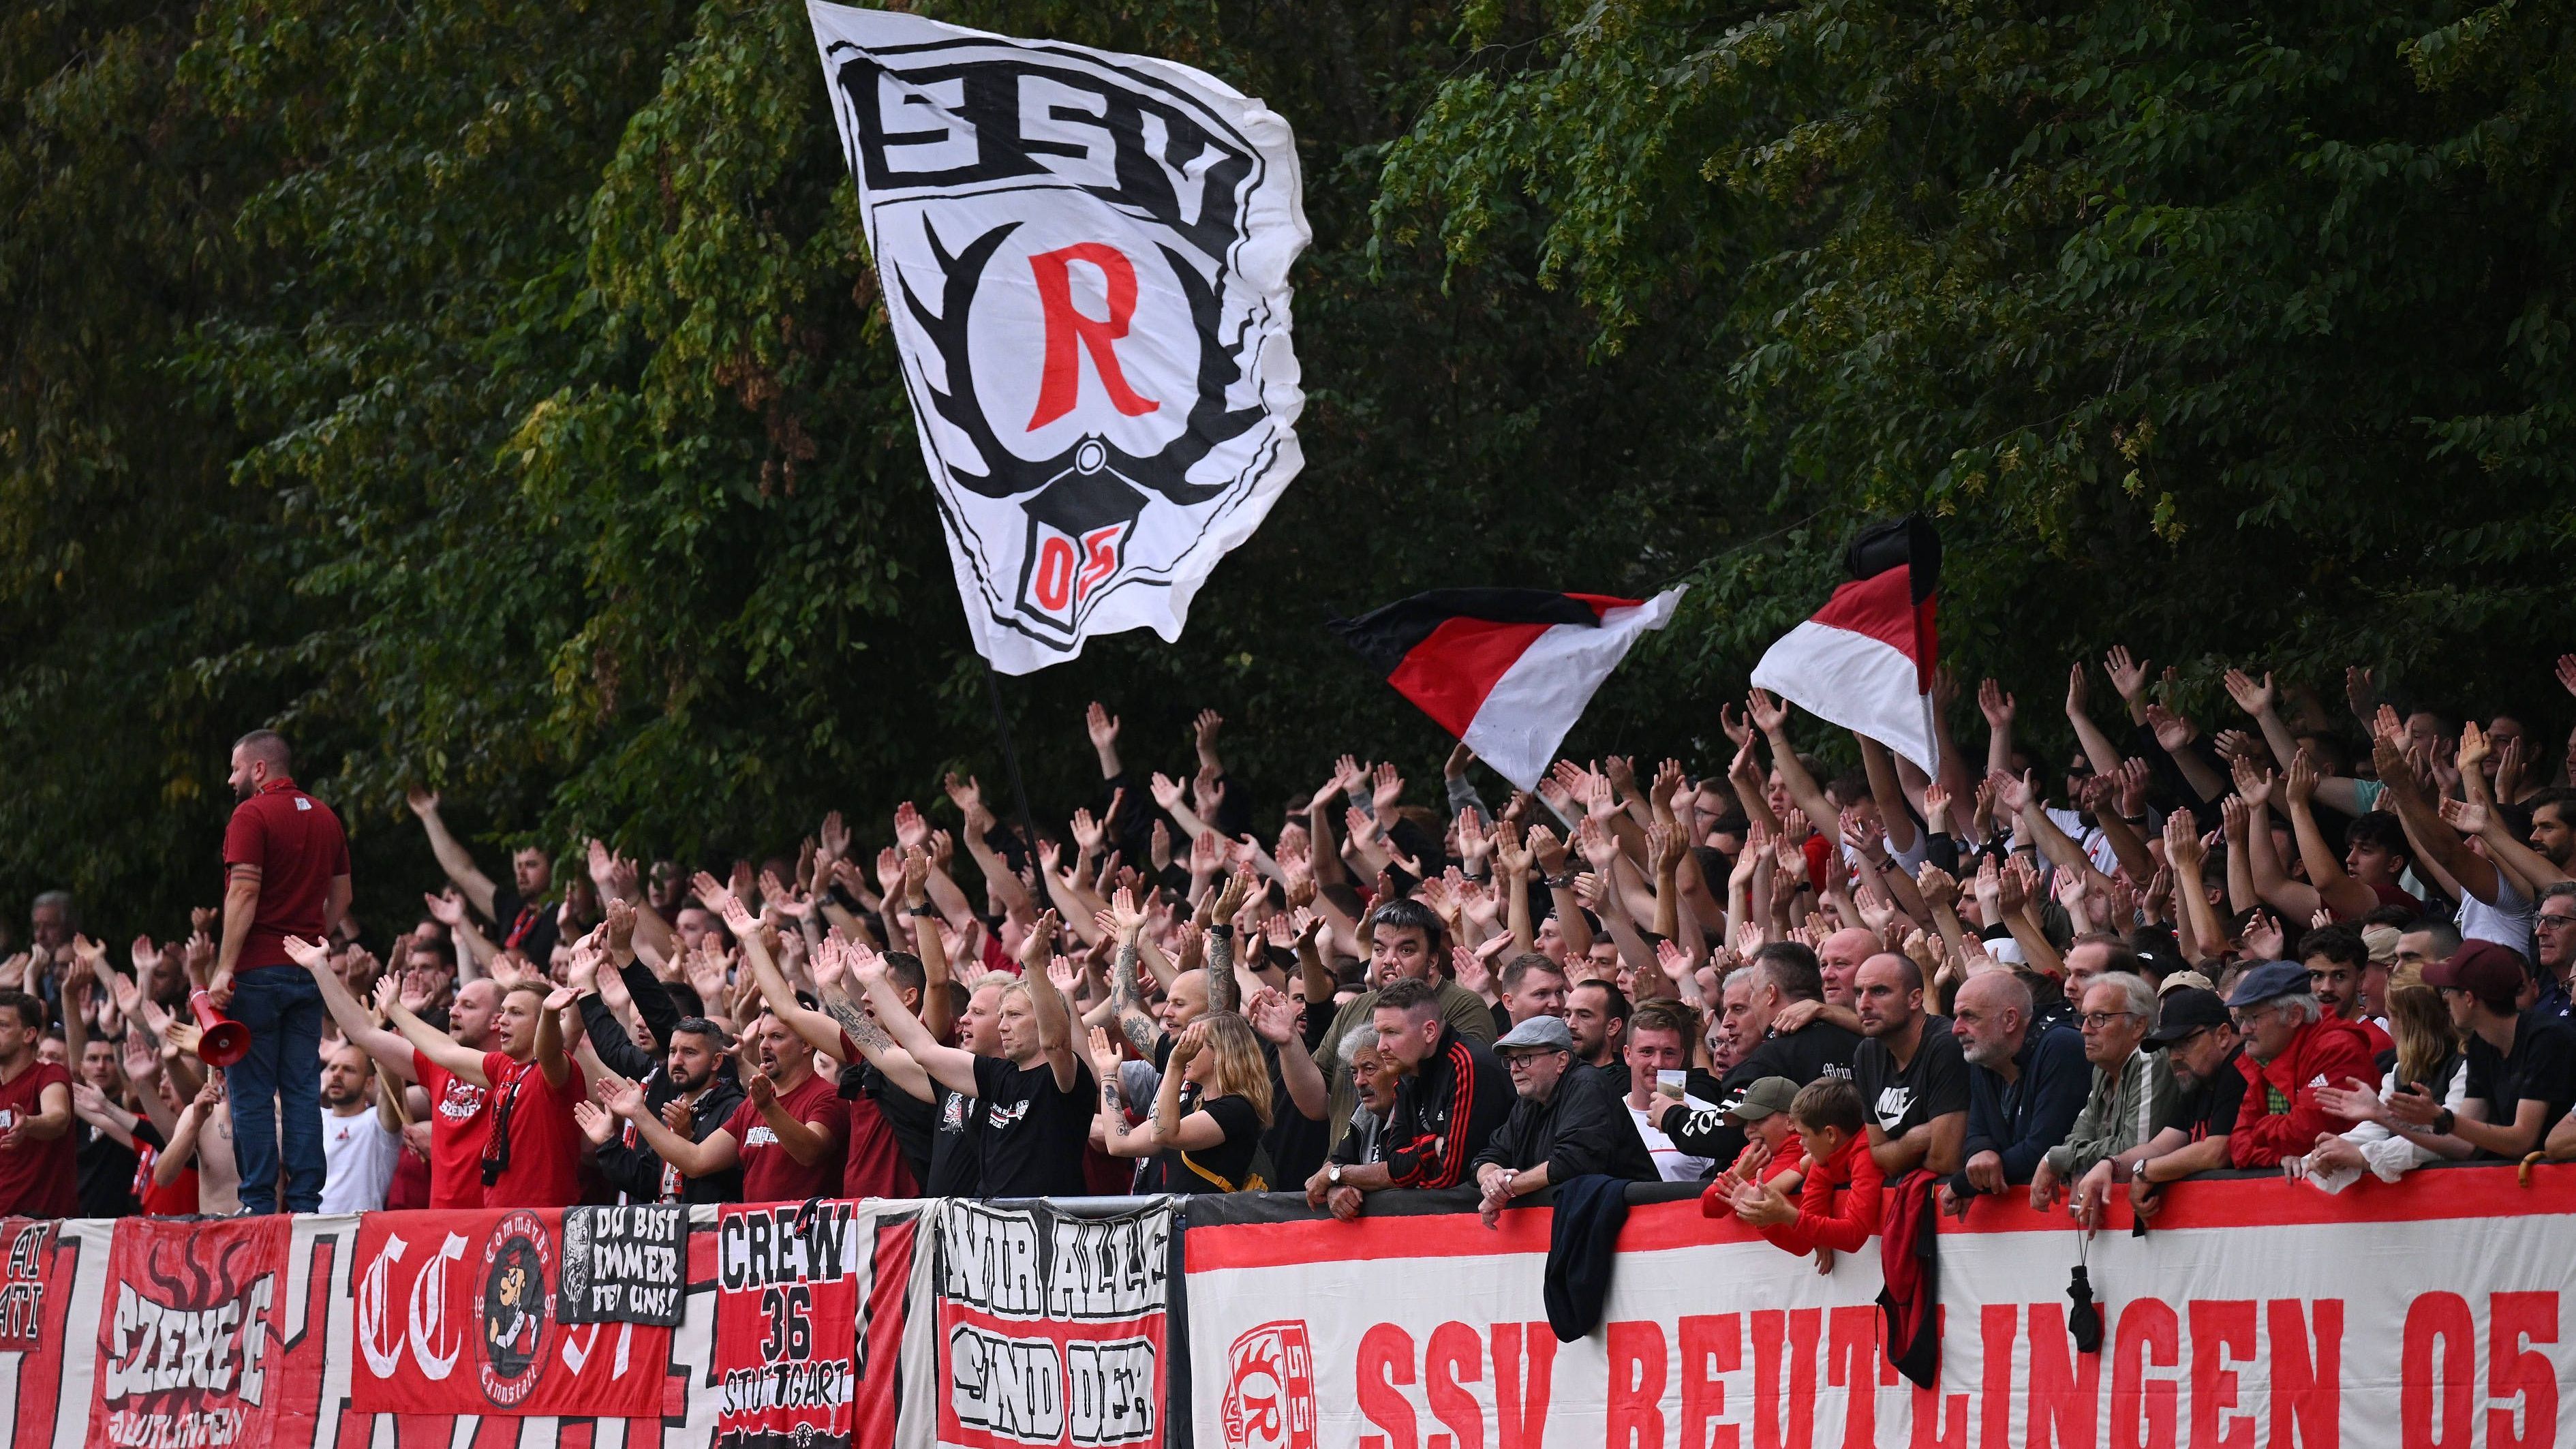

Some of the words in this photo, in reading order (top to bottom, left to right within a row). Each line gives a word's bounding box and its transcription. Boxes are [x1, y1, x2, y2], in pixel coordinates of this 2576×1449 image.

[876, 70, 1231, 227] SSV
[1025, 241, 1161, 433] R
[1034, 526, 1121, 611] 05
[1822, 1063, 1852, 1080] Mein
[485, 1215, 549, 1264] Commando
[596, 1206, 628, 1238] DU
[633, 1207, 680, 1242] BIST
[721, 1205, 852, 1292] CREW
[594, 1241, 678, 1285] IMMER
[937, 1203, 1043, 1316] WIR
[475, 1295, 485, 1319] 19
[545, 1294, 557, 1319] 97
[592, 1283, 623, 1312] BEI
[629, 1284, 679, 1317] UNS!
[761, 1285, 812, 1361] 36
[481, 1363, 538, 1403] Cannstatt
[722, 1360, 850, 1418] STUTTGART
[1355, 1320, 1558, 1449] SSV
[1606, 1296, 2344, 1449] REUTLINGEN
[2401, 1290, 2560, 1449] 05
